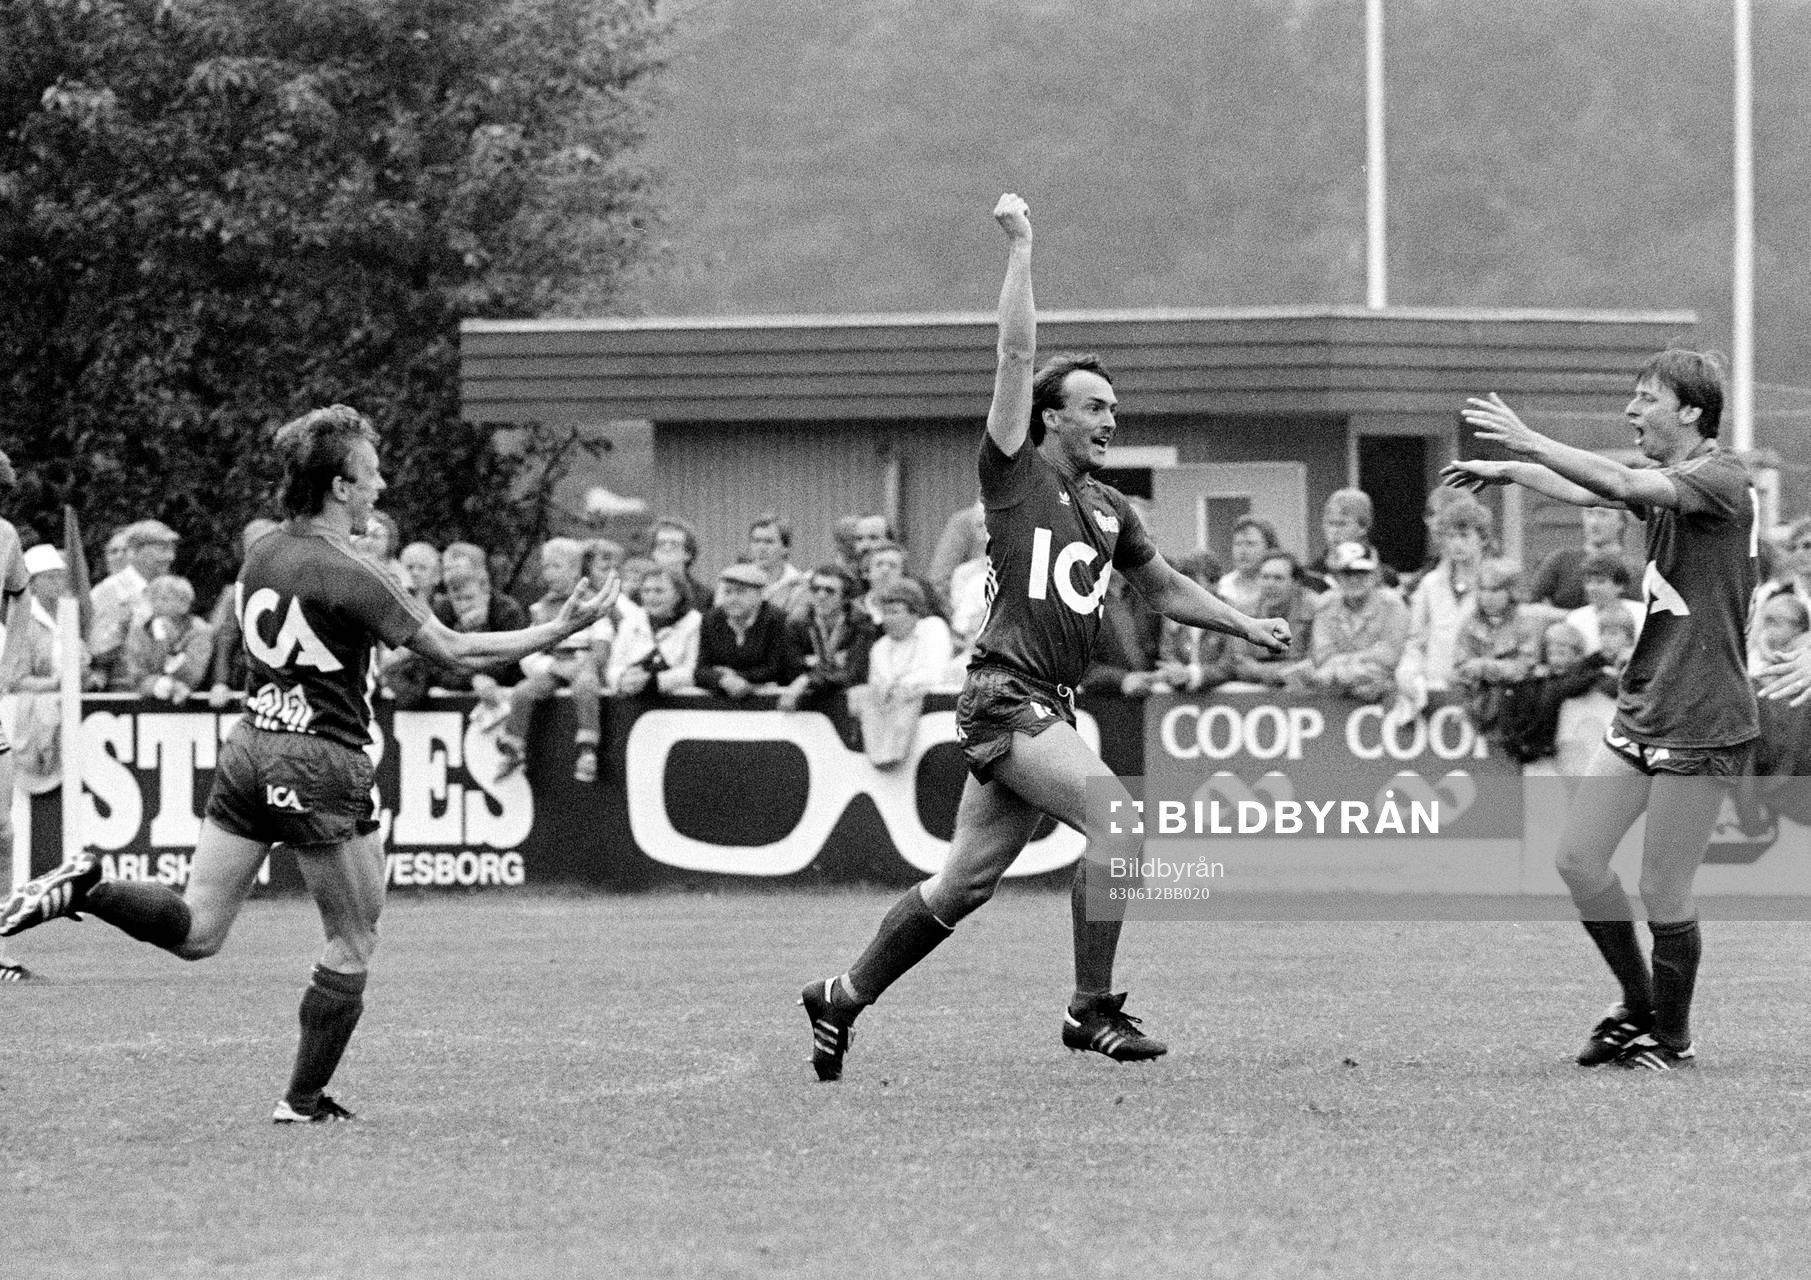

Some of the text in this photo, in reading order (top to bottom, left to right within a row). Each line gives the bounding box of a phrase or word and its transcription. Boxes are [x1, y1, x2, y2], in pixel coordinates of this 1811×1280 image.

[1160, 704, 1325, 760] COOP
[80, 711, 534, 850] STES
[266, 784, 305, 812] ICA
